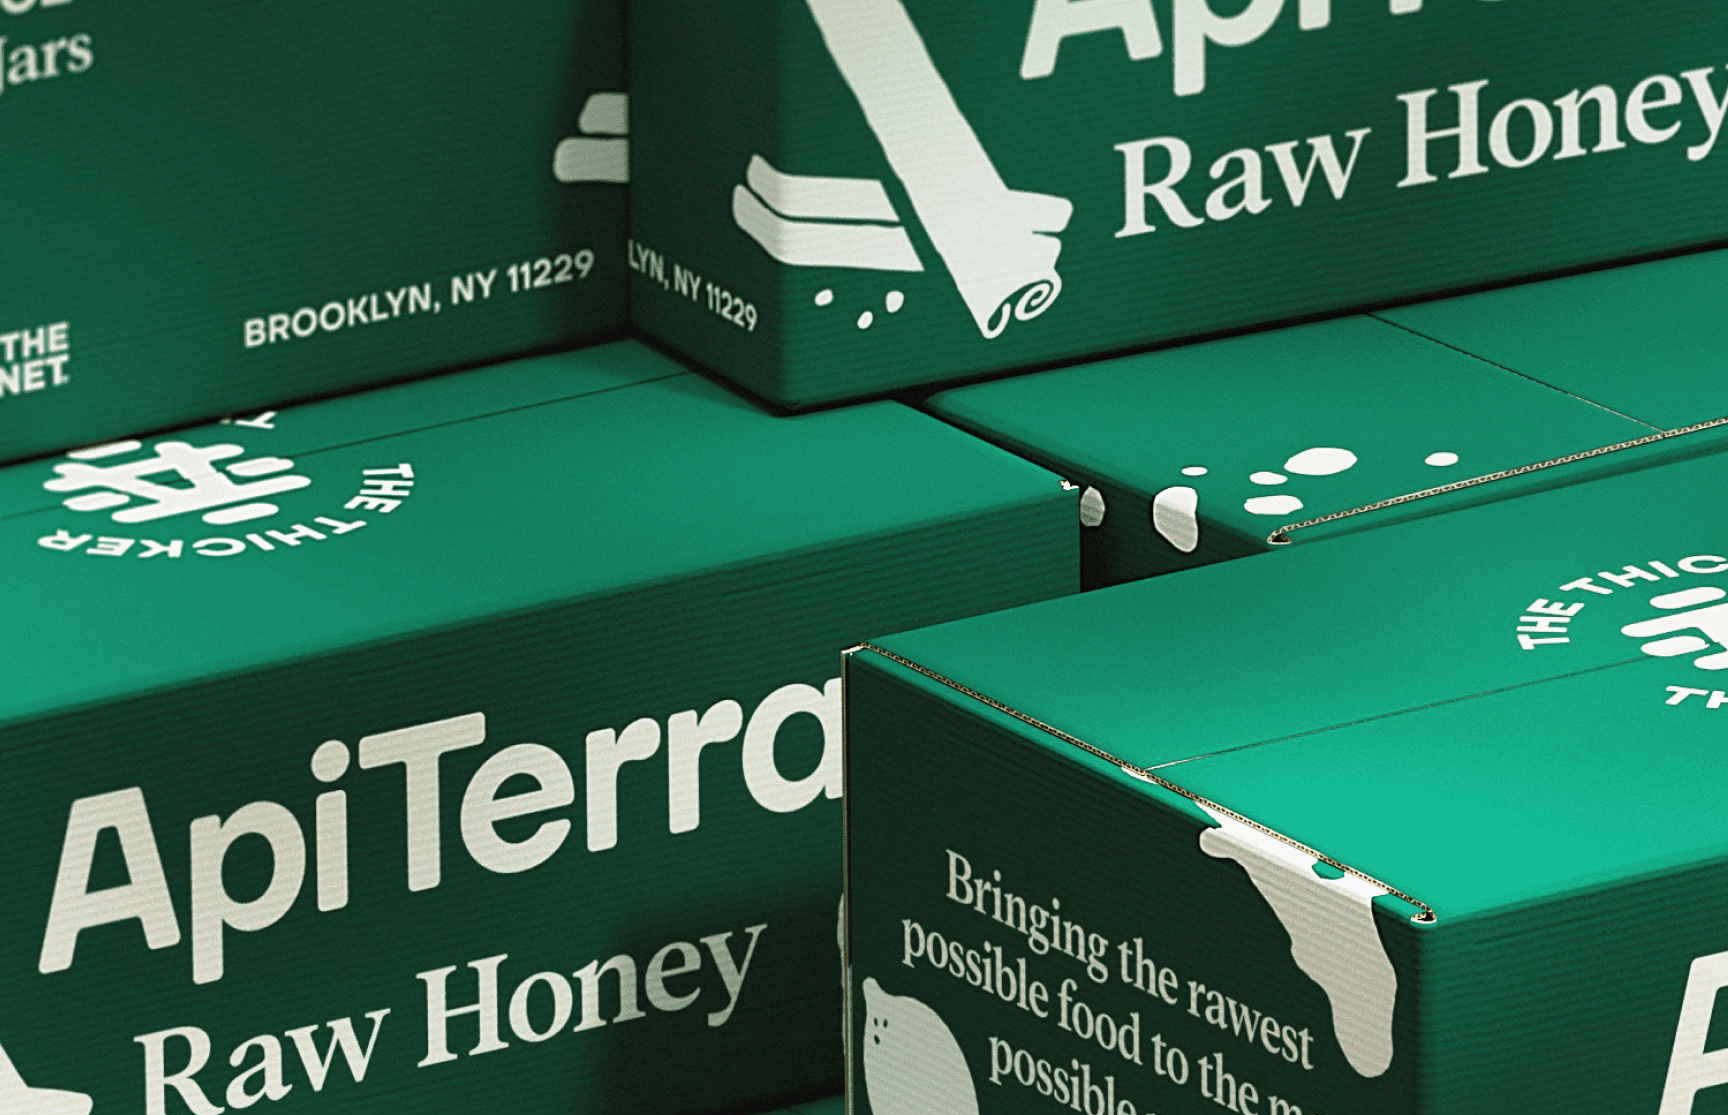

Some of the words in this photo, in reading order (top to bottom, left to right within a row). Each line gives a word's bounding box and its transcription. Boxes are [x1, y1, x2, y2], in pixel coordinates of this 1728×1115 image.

[0, 33, 94, 95] ars
[1113, 126, 1373, 238] Raw
[243, 282, 441, 348] BROOKLYN,
[450, 268, 498, 307] NY
[506, 248, 596, 294] 11229
[674, 263, 702, 302] NY
[706, 282, 759, 332] 11229
[0, 319, 70, 362] THE
[343, 462, 415, 514] THE
[37, 516, 368, 559] THICKER
[1515, 597, 1585, 651] THE
[38, 676, 843, 985] ApiTerra
[416, 923, 768, 1068] Honey
[902, 917, 1049, 1018] possible
[1057, 978, 1143, 1066] food
[1151, 1033, 1190, 1085] to
[946, 849, 1109, 983] Bringing
[1118, 937, 1179, 1005] the
[1187, 980, 1315, 1070] rawest
